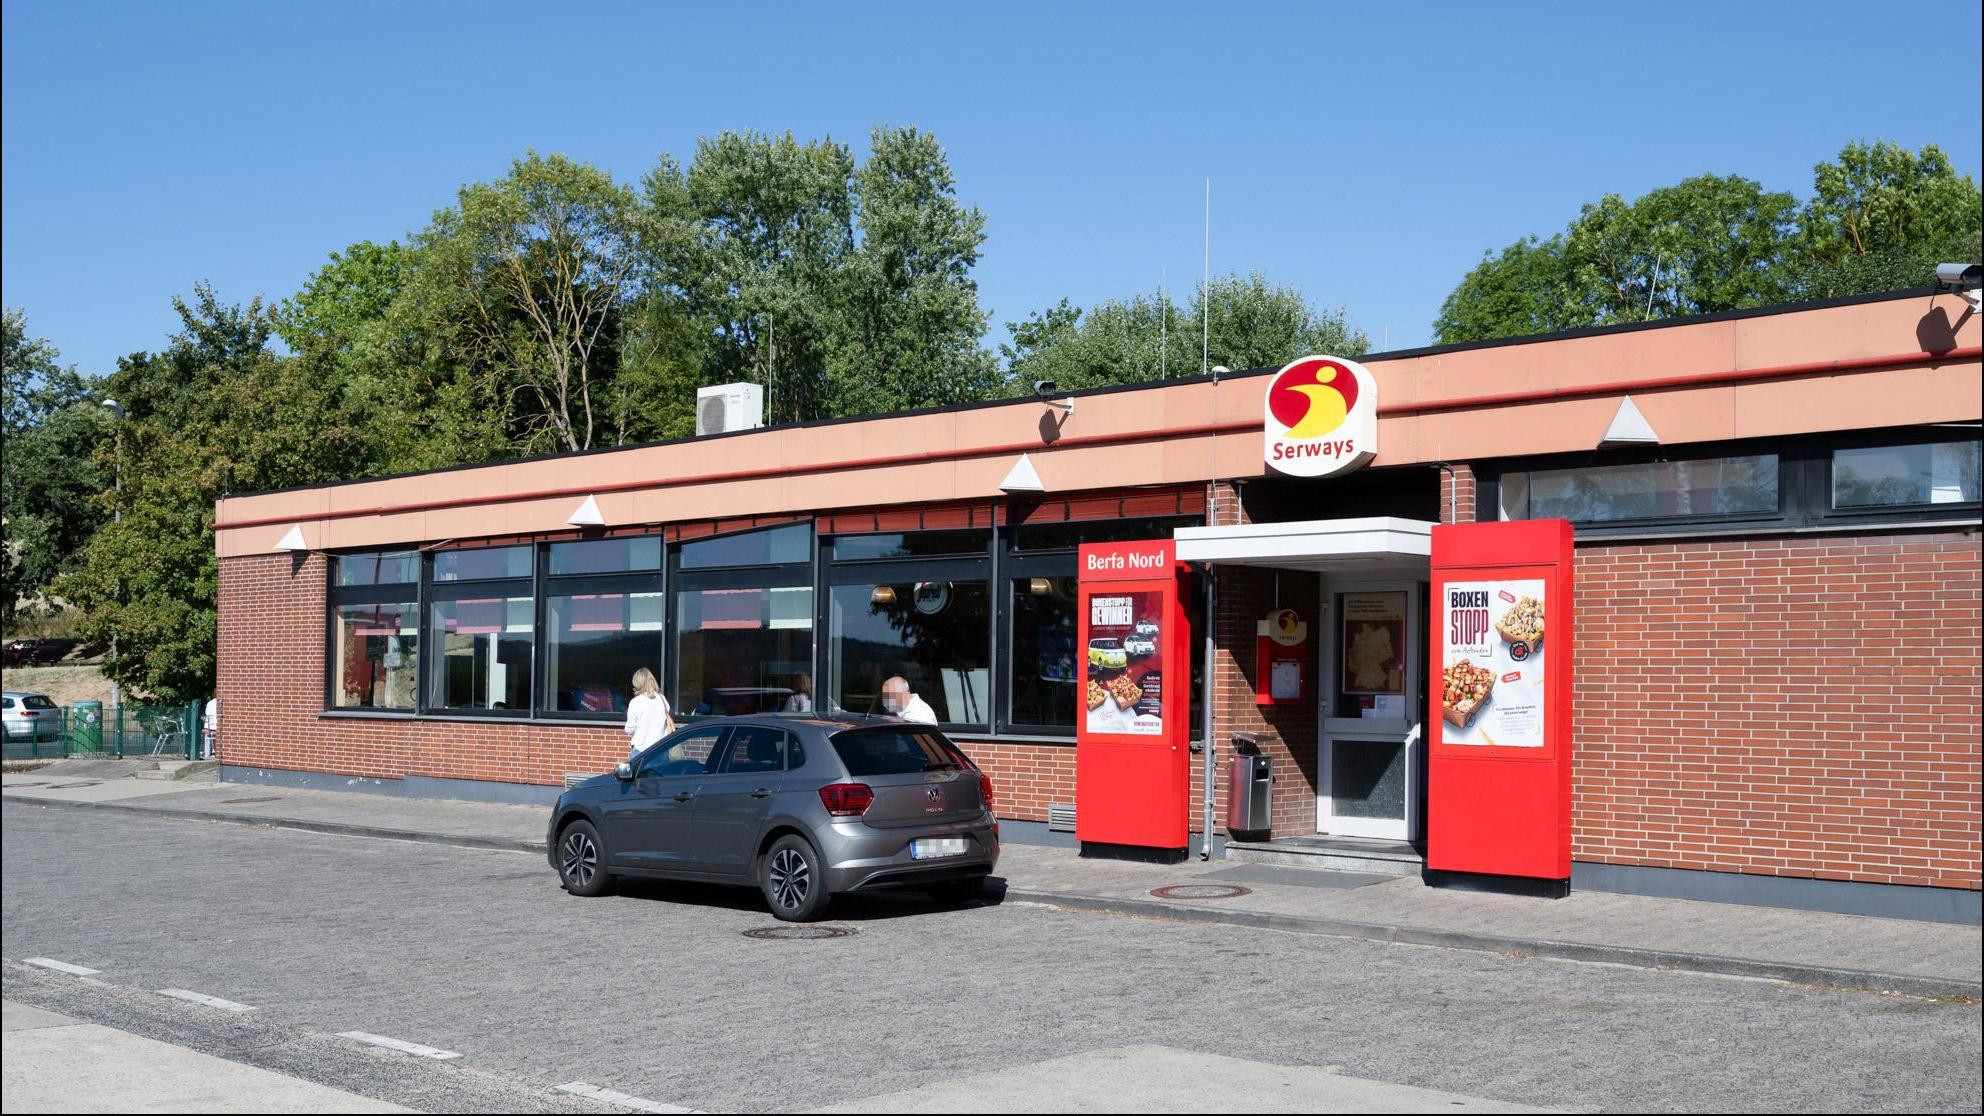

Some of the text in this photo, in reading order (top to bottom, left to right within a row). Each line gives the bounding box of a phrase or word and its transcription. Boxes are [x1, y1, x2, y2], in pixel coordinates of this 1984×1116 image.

[1272, 439, 1354, 460] Serways
[1087, 550, 1164, 570] Berfa Nord
[1451, 591, 1489, 608] BOXEN
[1451, 609, 1489, 645] STOPP
